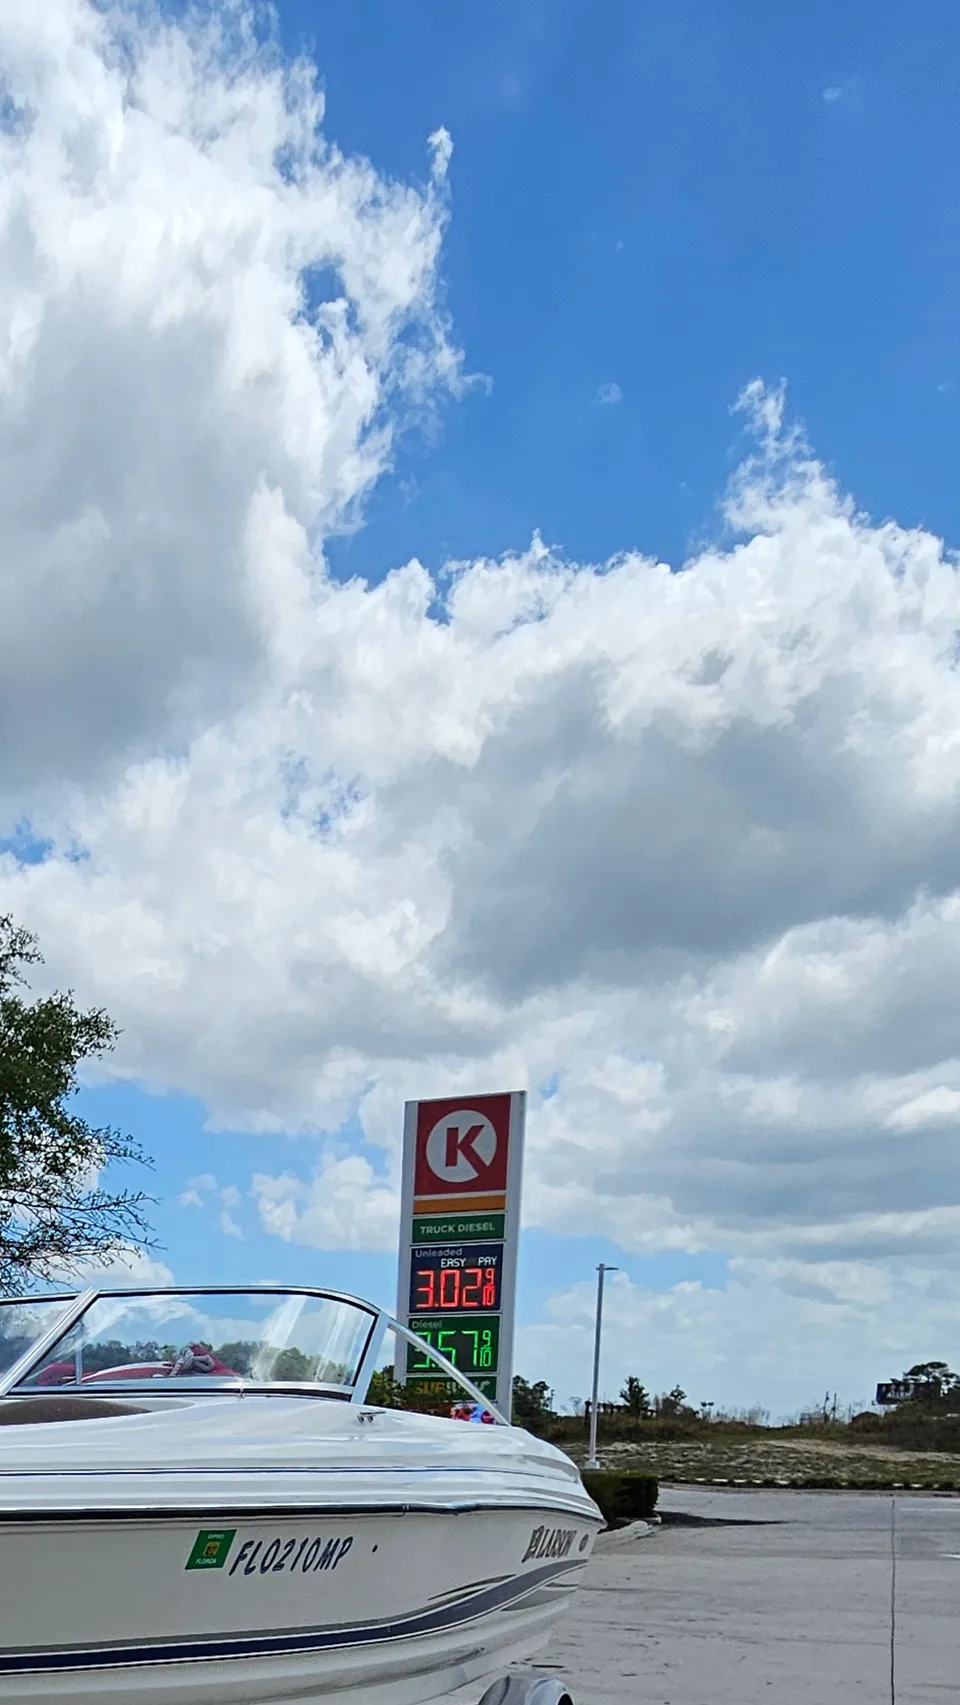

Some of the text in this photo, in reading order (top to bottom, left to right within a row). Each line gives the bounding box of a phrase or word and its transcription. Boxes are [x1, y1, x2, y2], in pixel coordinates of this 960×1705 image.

[445, 1124, 489, 1176] K
[420, 1222, 495, 1235] TRUCK DIESEL
[415, 1248, 463, 1258] Unleaded
[440, 1256, 498, 1268] EASY PAY
[411, 1319, 442, 1329] Diesel
[229, 1537, 353, 1576] FL0210MP
